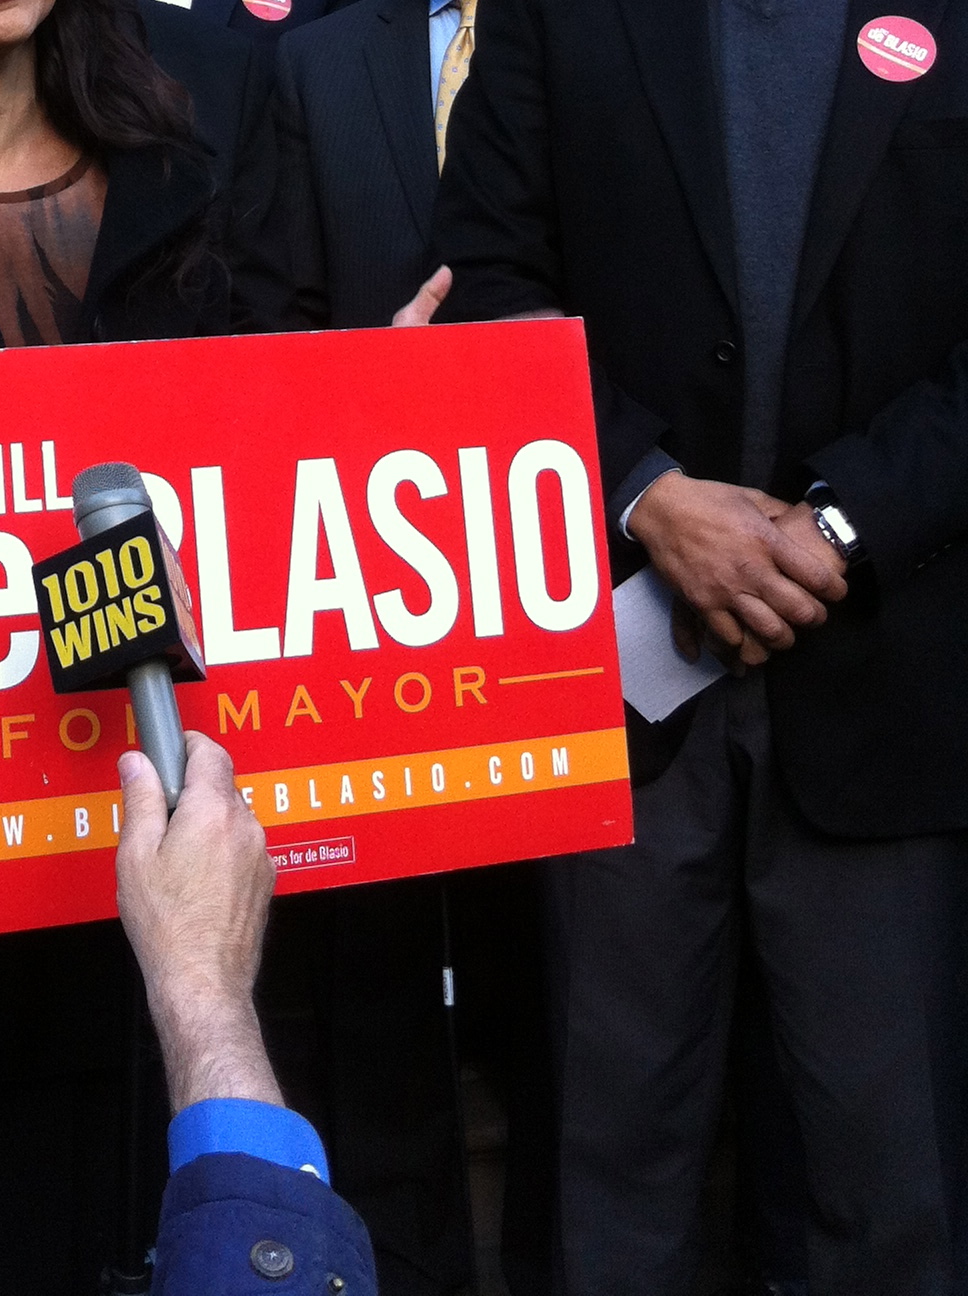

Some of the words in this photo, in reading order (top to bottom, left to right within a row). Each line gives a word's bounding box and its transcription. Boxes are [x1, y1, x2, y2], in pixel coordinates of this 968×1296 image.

[884, 35, 928, 62] BLASIO
[41, 535, 156, 624] 1010
[140, 439, 602, 667] LASIO
[49, 584, 167, 670] WINS
[0, 706, 142, 760] FO
[218, 665, 488, 736] MAYOR
[289, 851, 303, 865] for
[305, 848, 318, 863] de
[319, 845, 349, 860] Blasio
